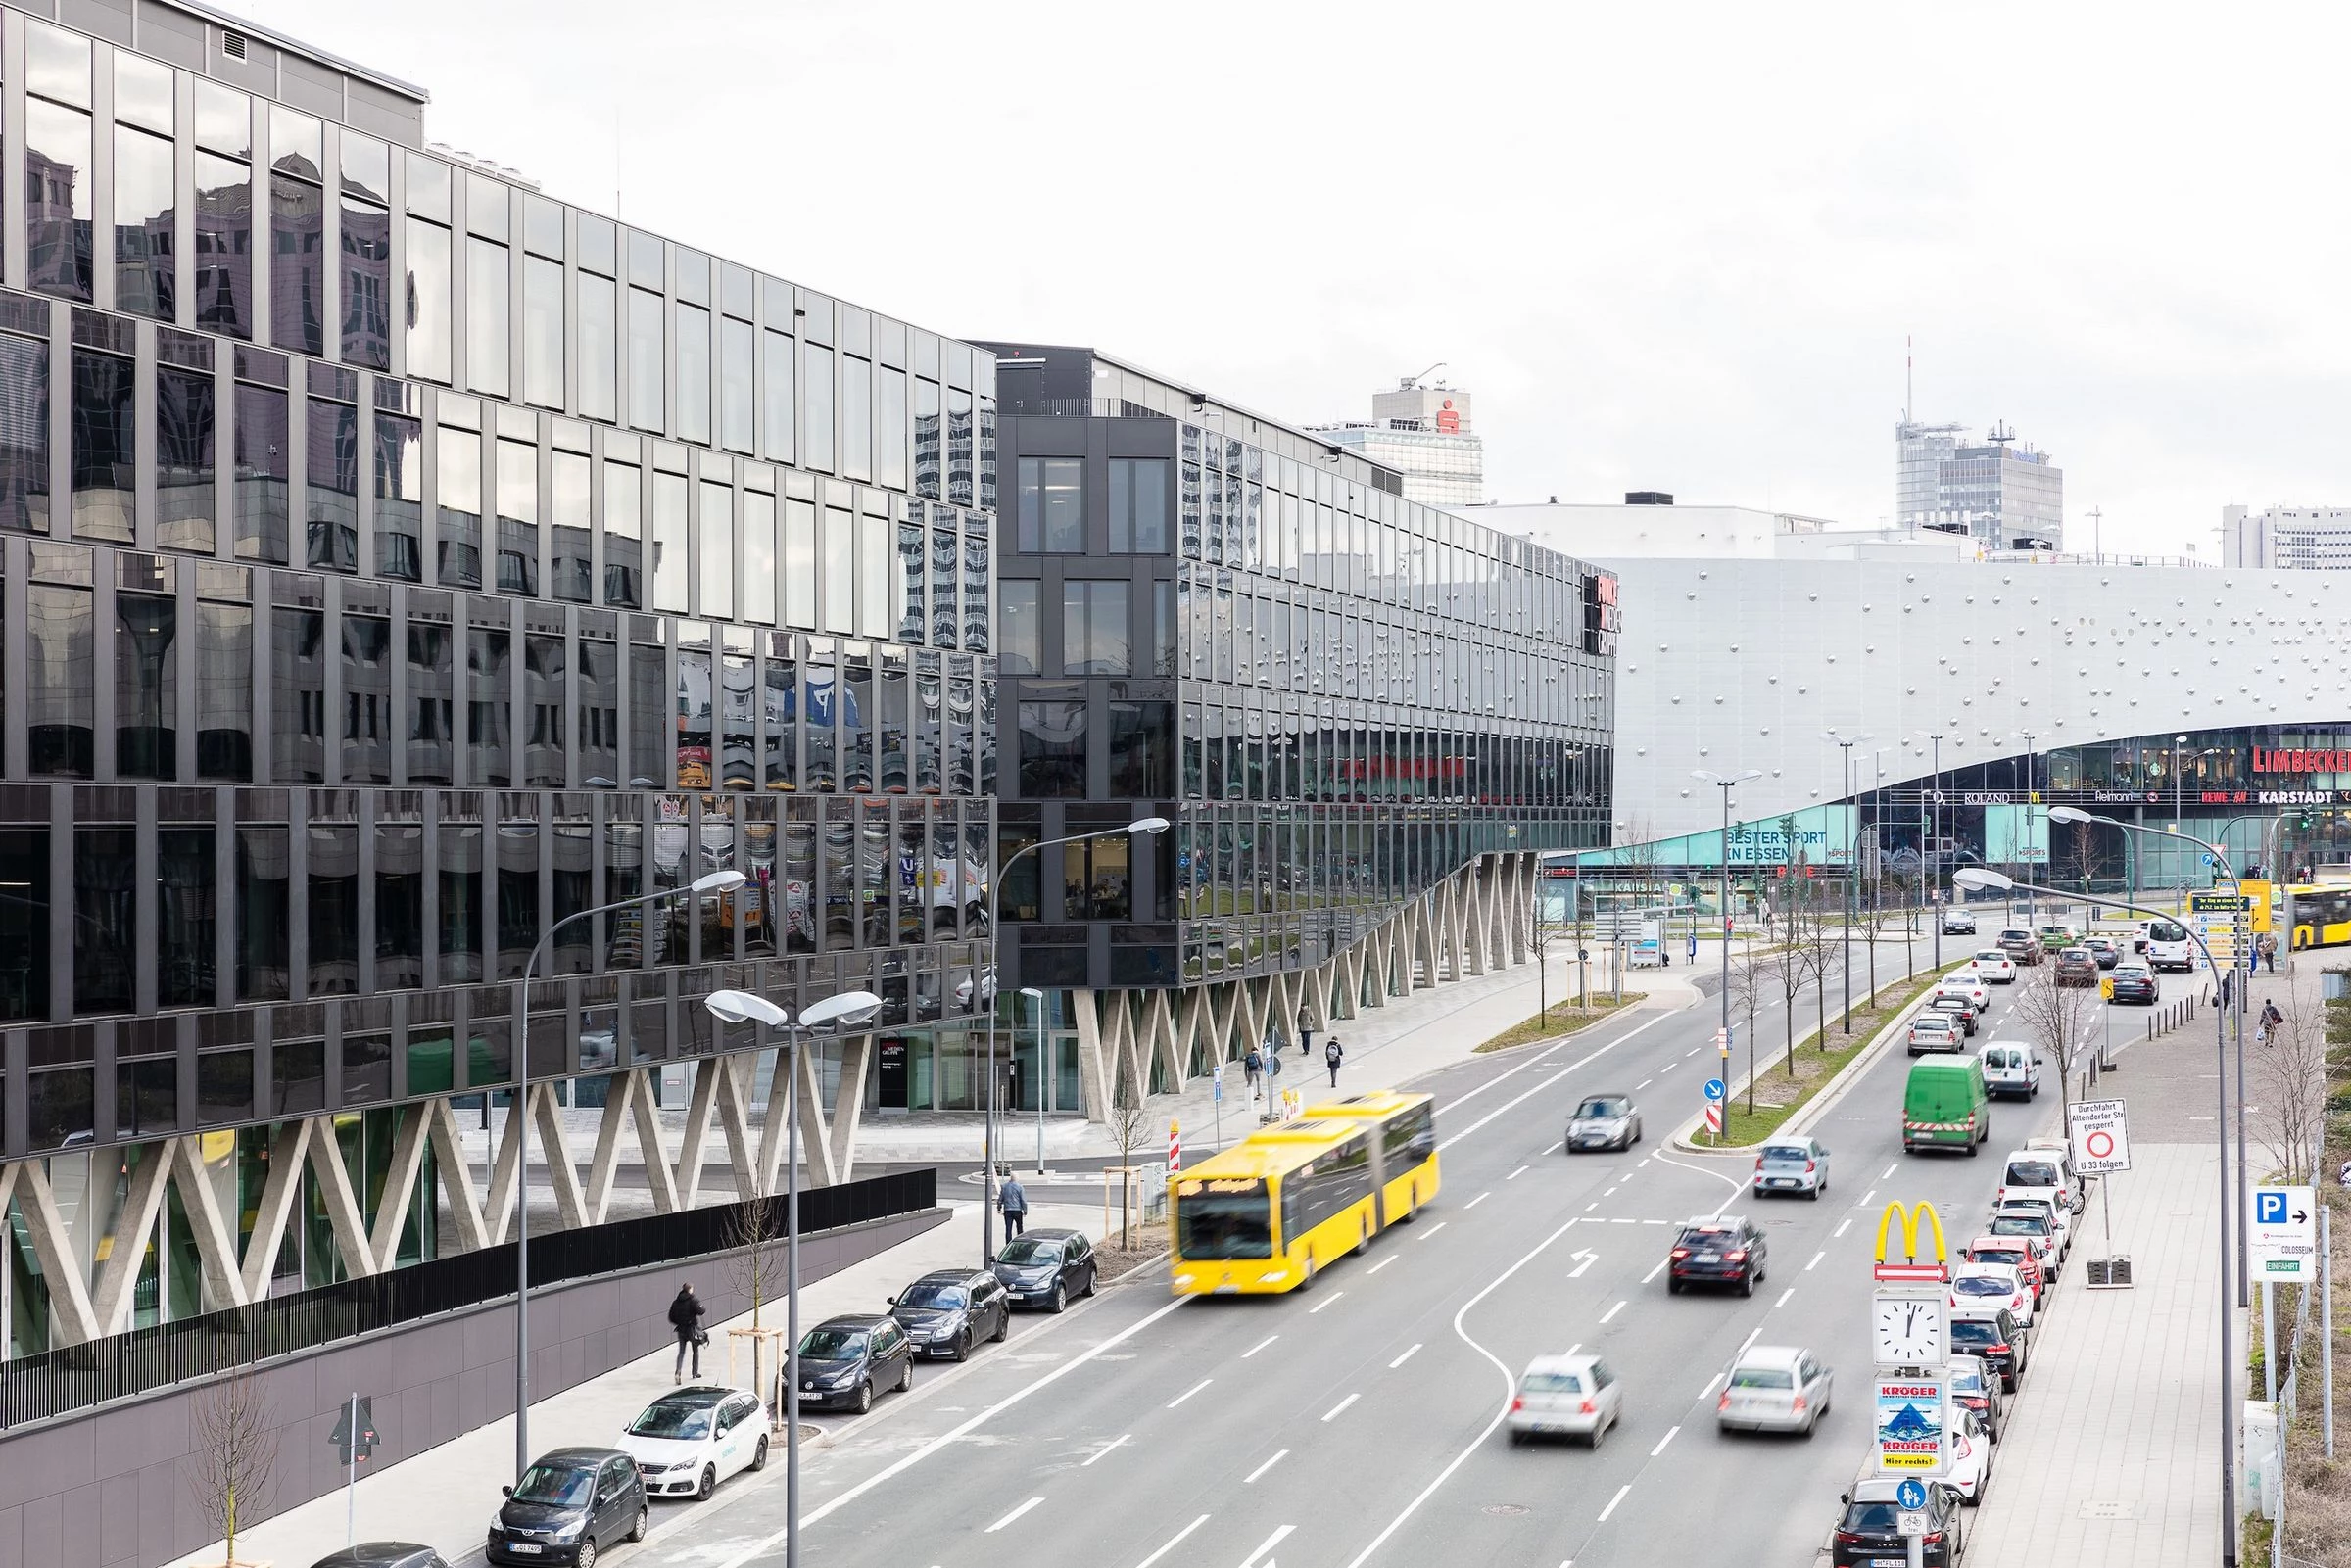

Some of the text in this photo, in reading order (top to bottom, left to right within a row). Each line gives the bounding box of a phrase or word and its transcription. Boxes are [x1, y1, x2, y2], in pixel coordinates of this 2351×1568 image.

[1964, 793, 2010, 804] ROLAND
[2201, 791, 2228, 803] REWE
[2259, 791, 2332, 803] KARSTADT
[1727, 832, 1779, 844] BESTER
[1746, 848, 1790, 860] ESSEN
[1615, 883, 1670, 892] KARSTAD
[2078, 1103, 2116, 1114] Durchfahrt
[2072, 1113, 2111, 1122] Altendorfer
[2084, 1120, 2114, 1131] gesperrt
[2099, 1160, 2124, 1169] folgen
[2262, 1195, 2281, 1221] P
[2281, 1246, 2313, 1255] COLOSSEUM
[2267, 1261, 2299, 1270] EINFAHRT
[1882, 1386, 1937, 1396] KRÖGER
[1883, 1441, 1938, 1450] KRÖGER
